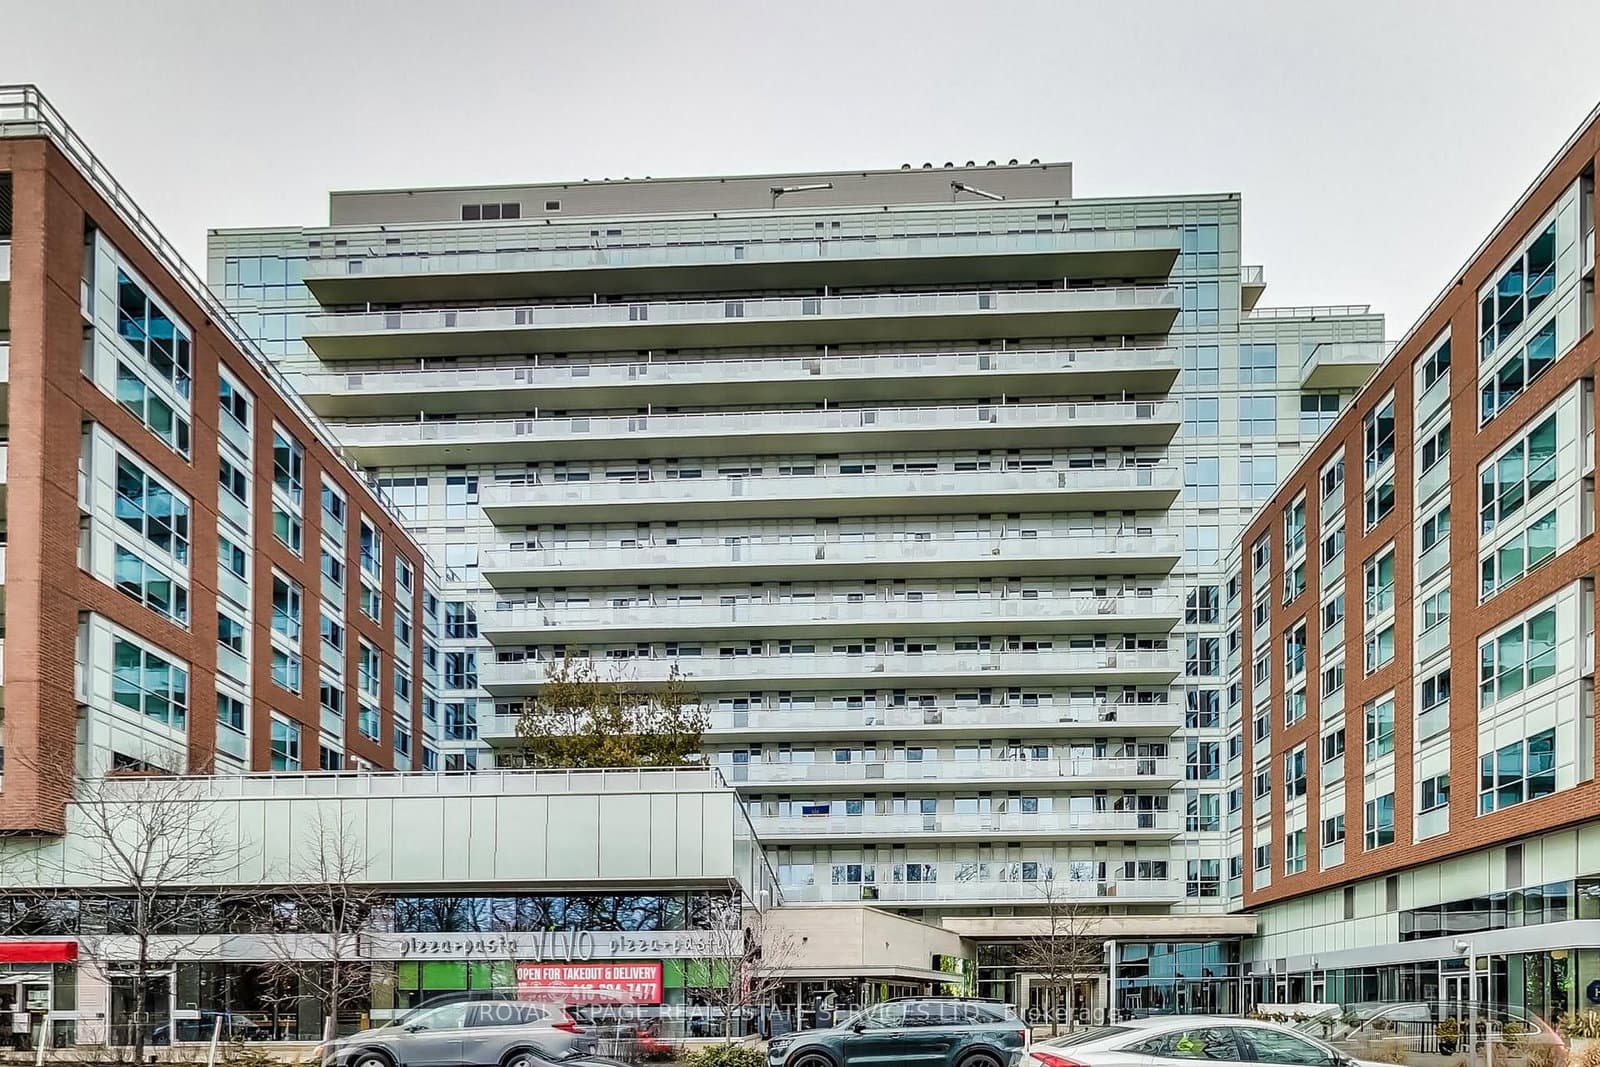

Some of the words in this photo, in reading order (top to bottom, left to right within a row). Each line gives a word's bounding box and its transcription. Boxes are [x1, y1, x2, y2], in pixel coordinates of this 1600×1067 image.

[530, 926, 592, 961] VIVO
[517, 966, 541, 980] OPEN
[543, 966, 561, 980] FOR
[563, 966, 602, 980] TAKEOUT
[604, 967, 612, 980] &
[613, 966, 657, 980] DELIVERY
